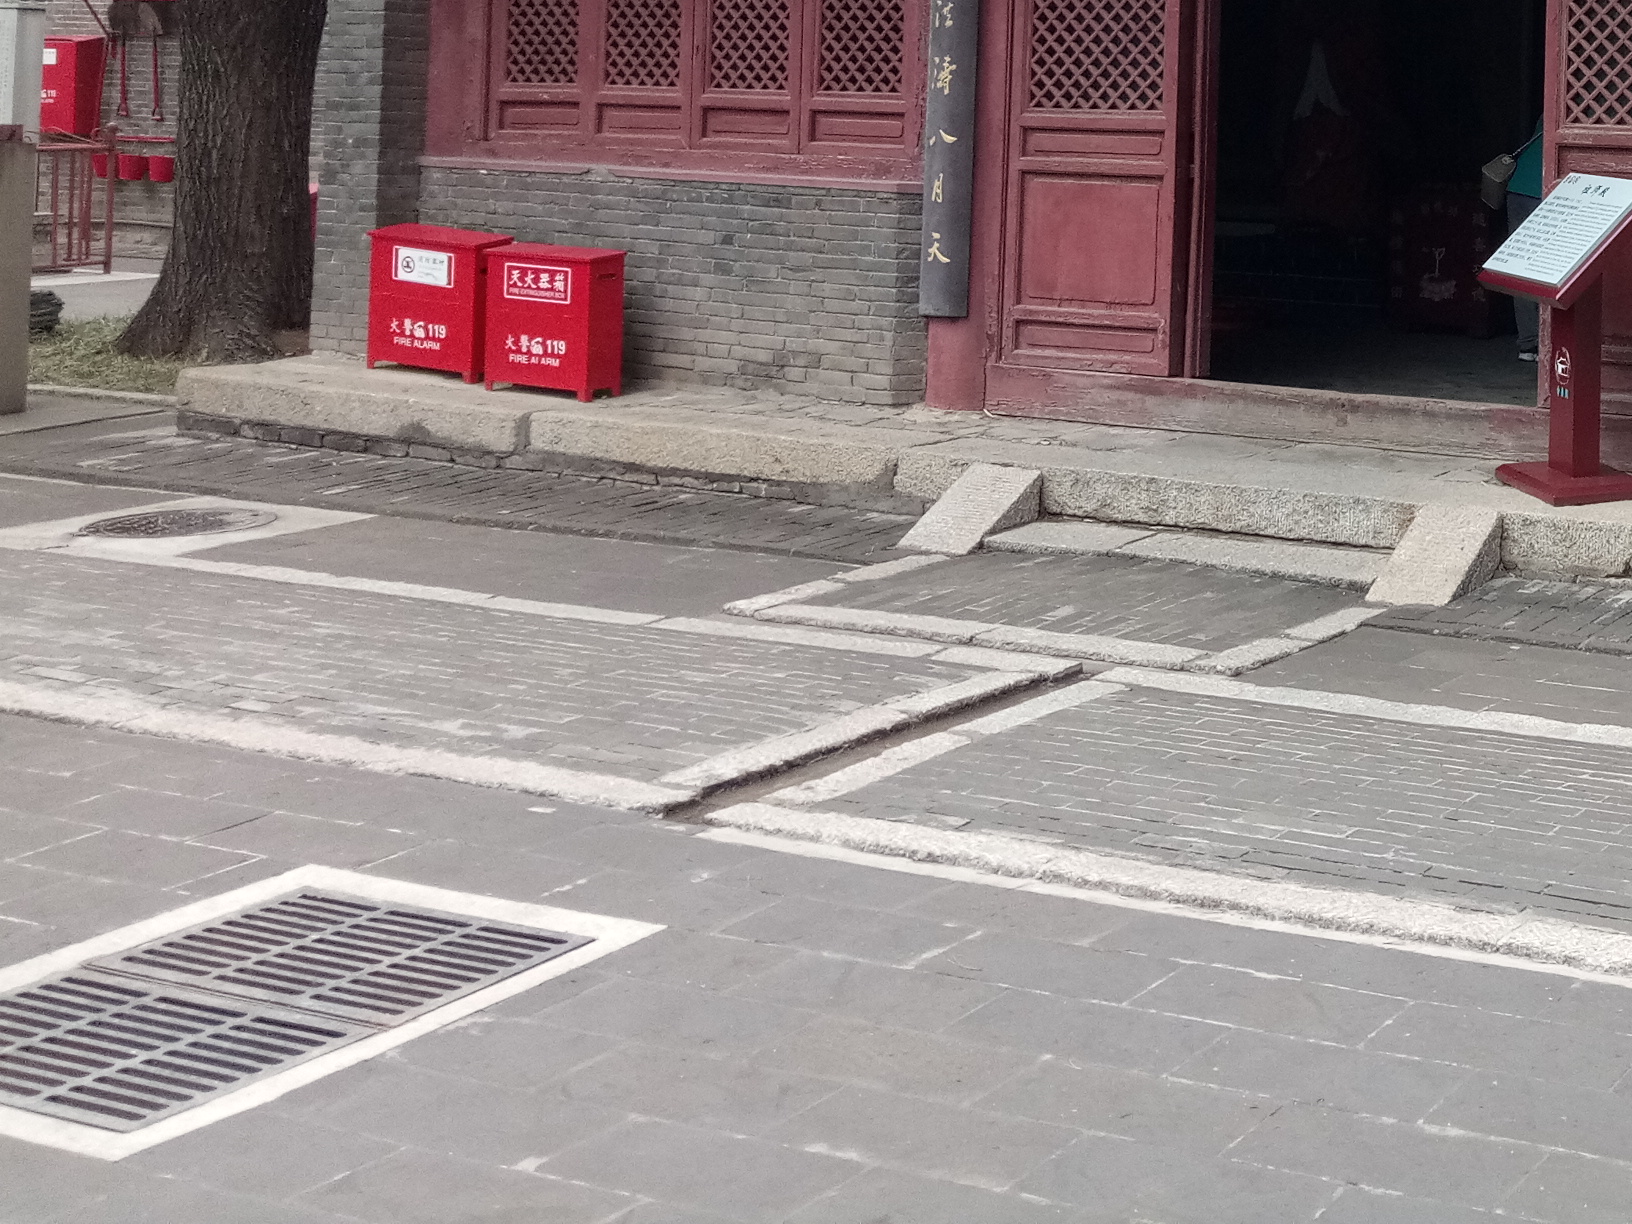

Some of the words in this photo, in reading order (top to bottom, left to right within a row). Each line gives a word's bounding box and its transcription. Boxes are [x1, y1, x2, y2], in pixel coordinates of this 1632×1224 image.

[509, 270, 565, 292] 灭火器箱
[428, 323, 447, 338] 119
[393, 336, 412, 346] FIRE
[413, 339, 441, 350] ALARM
[546, 339, 566, 354] 119
[509, 354, 529, 364] FIRE
